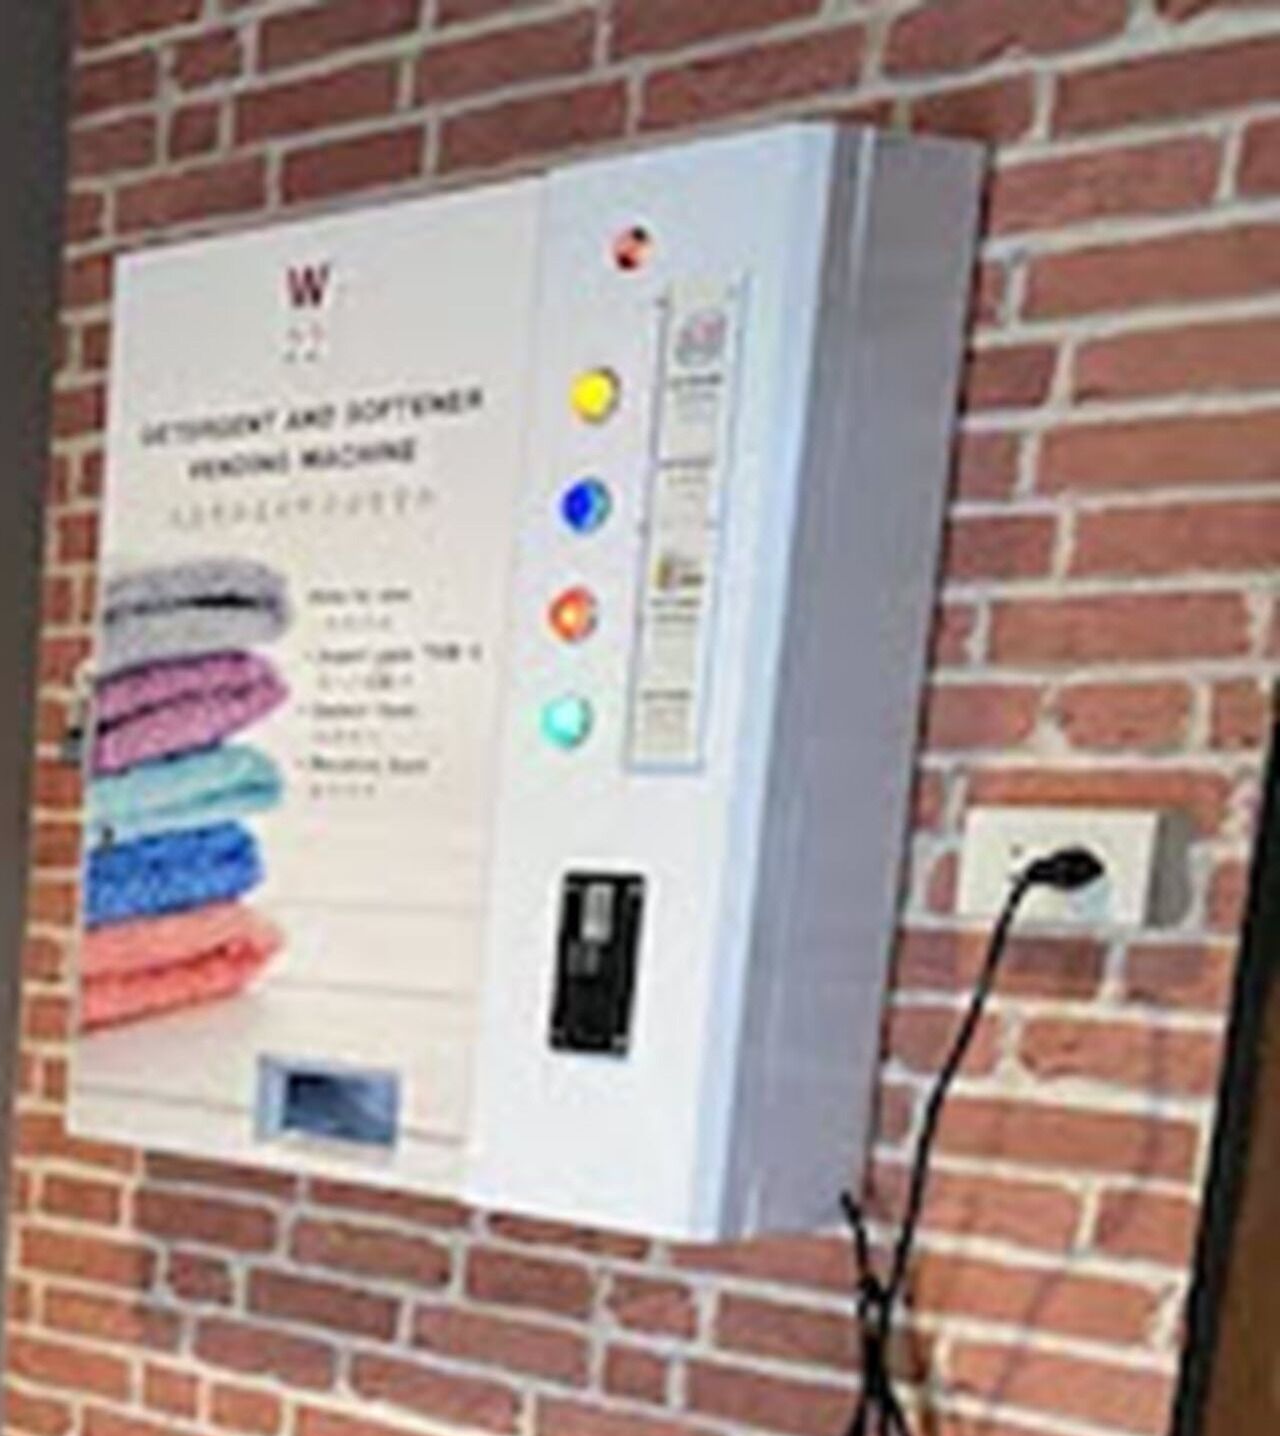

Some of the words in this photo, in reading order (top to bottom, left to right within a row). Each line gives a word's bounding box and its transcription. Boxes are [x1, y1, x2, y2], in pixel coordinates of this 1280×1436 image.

[287, 262, 331, 308] W
[285, 402, 335, 432] AND
[302, 437, 416, 471] MACHINE
